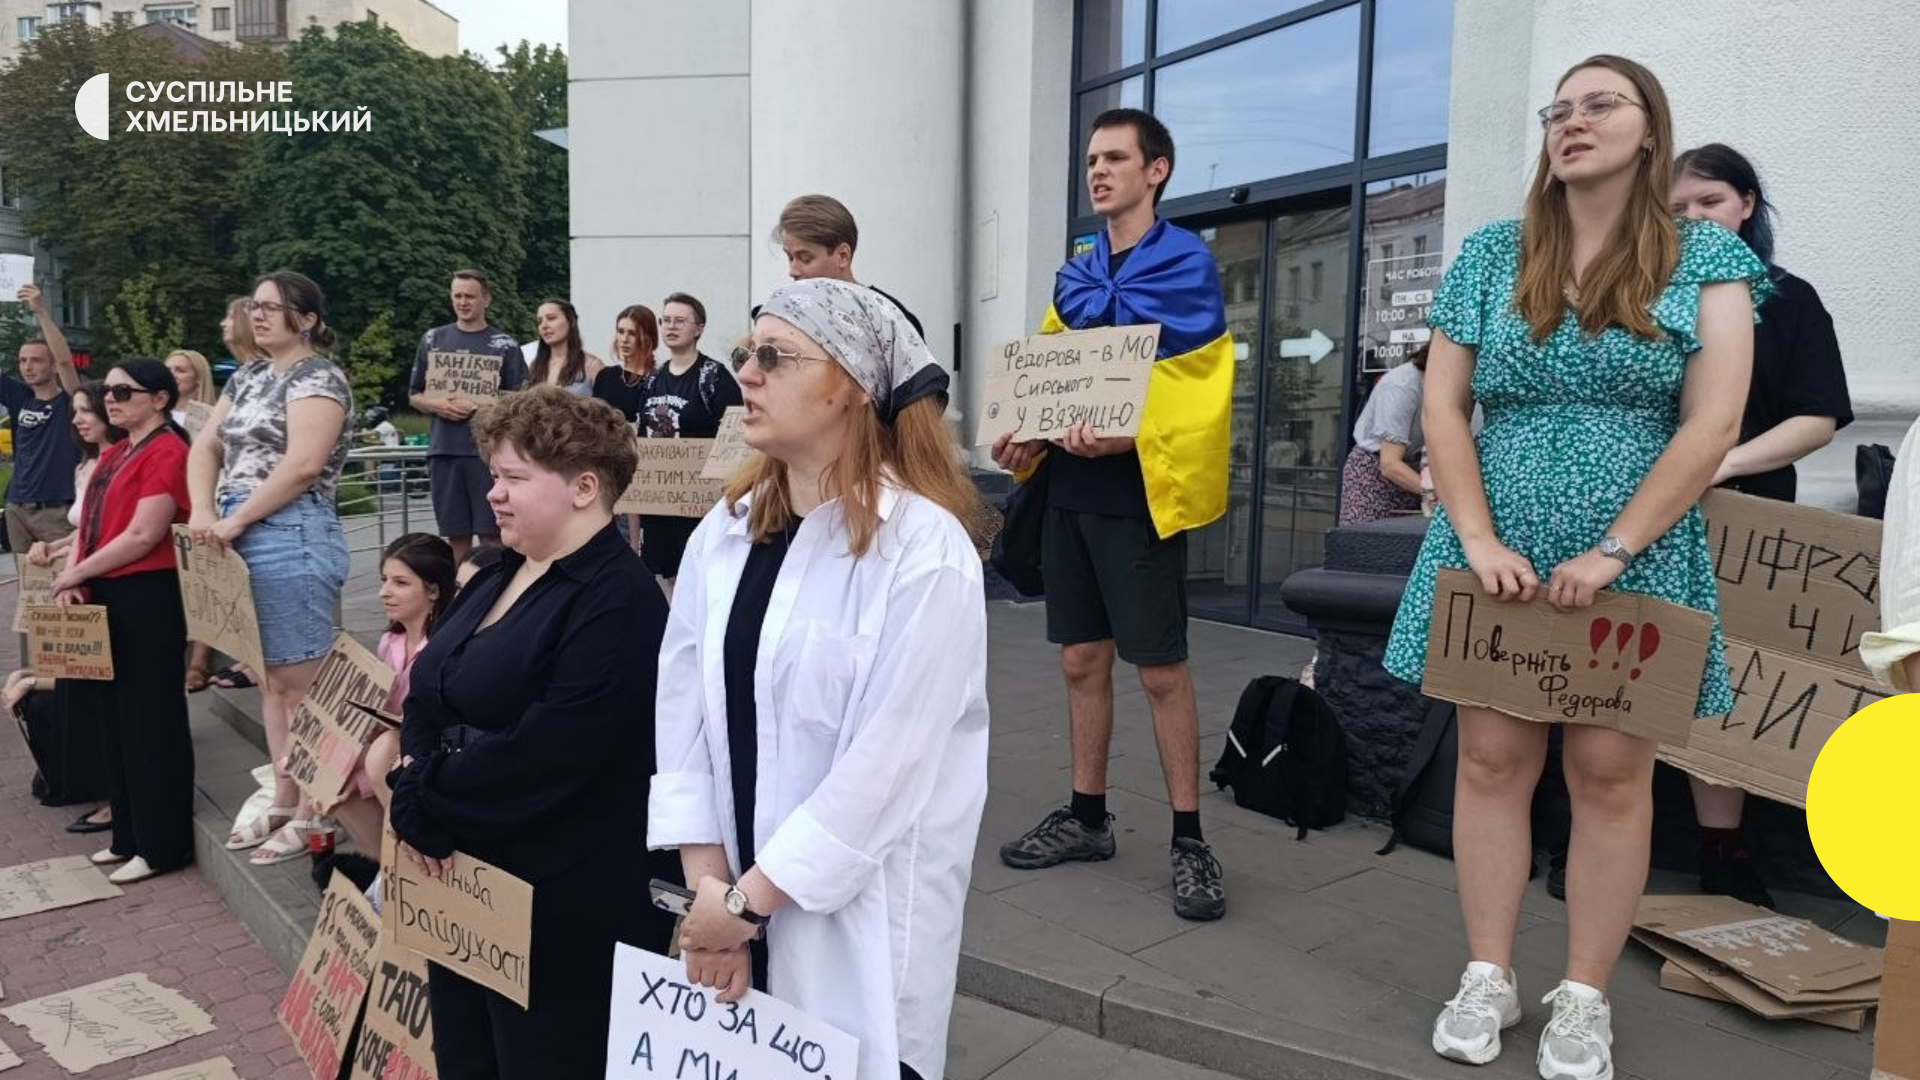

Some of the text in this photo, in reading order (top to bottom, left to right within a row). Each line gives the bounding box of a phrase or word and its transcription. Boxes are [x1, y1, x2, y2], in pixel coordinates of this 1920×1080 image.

[1375, 308, 1405, 322] 10:00
[1443, 591, 1571, 676] Поверніть
[1538, 674, 1632, 718] Федорова
[378, 960, 431, 1040] ТАТО
[639, 971, 706, 1022] ХТО
[718, 1001, 757, 1044] ЗА
[631, 1032, 653, 1071] А
